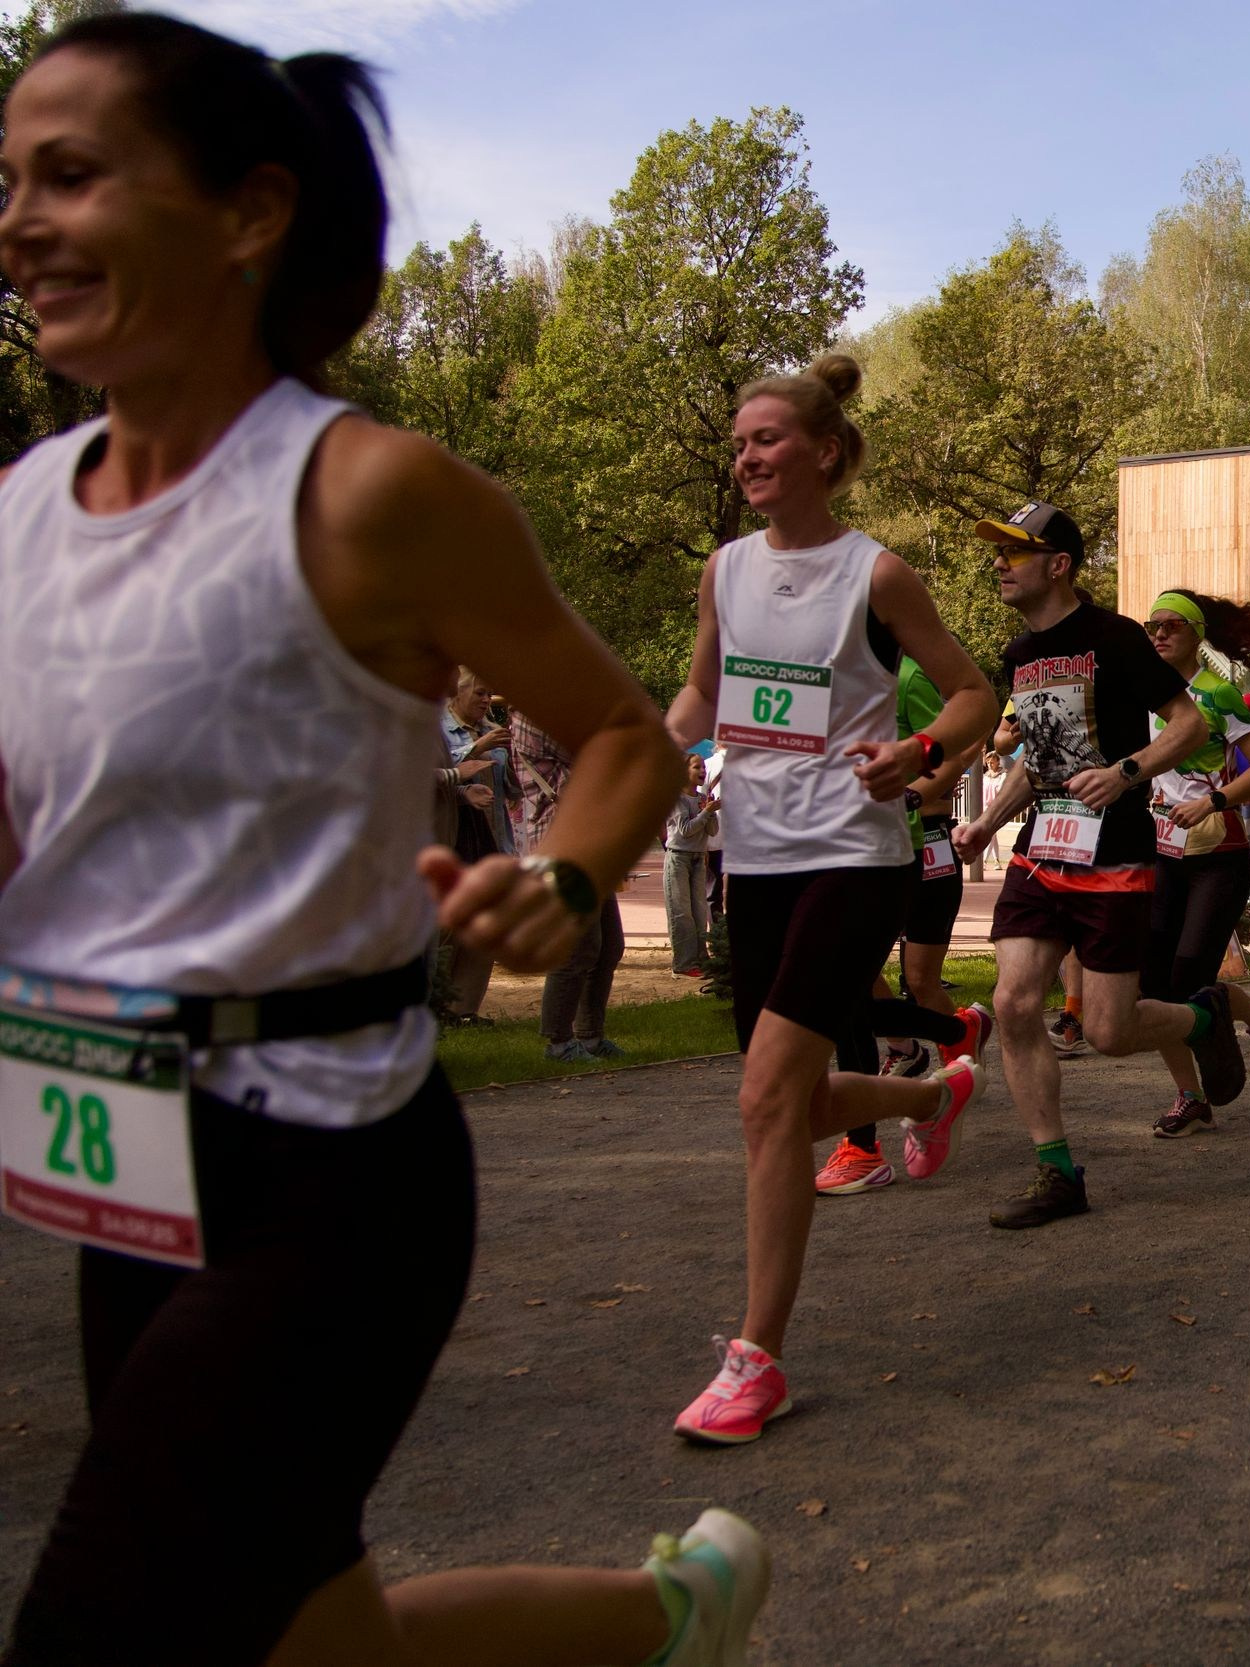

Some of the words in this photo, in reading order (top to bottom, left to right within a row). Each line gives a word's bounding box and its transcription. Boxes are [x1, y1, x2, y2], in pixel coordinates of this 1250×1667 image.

[734, 662, 776, 677] КРОСС
[777, 668, 820, 682] ДУБКИ
[752, 686, 793, 726] 62
[777, 737, 815, 748] 14.09.25
[1065, 805, 1095, 816] ДУБКИ
[1045, 818, 1079, 844] 140
[1156, 817, 1175, 841] 02
[41, 1082, 116, 1186] 28
